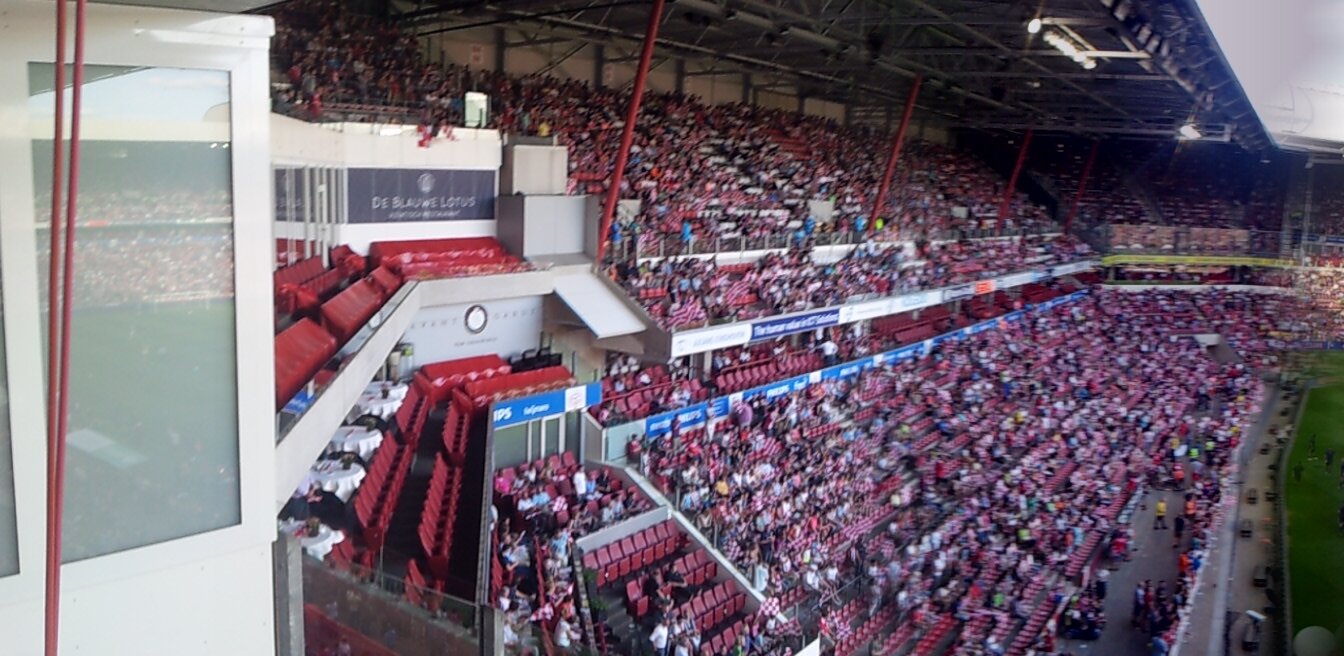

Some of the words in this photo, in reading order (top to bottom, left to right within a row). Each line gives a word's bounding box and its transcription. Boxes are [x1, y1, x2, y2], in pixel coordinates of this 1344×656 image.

[371, 196, 390, 209] DE
[391, 196, 438, 209] BLAUWE
[440, 196, 476, 208] LOTUS
